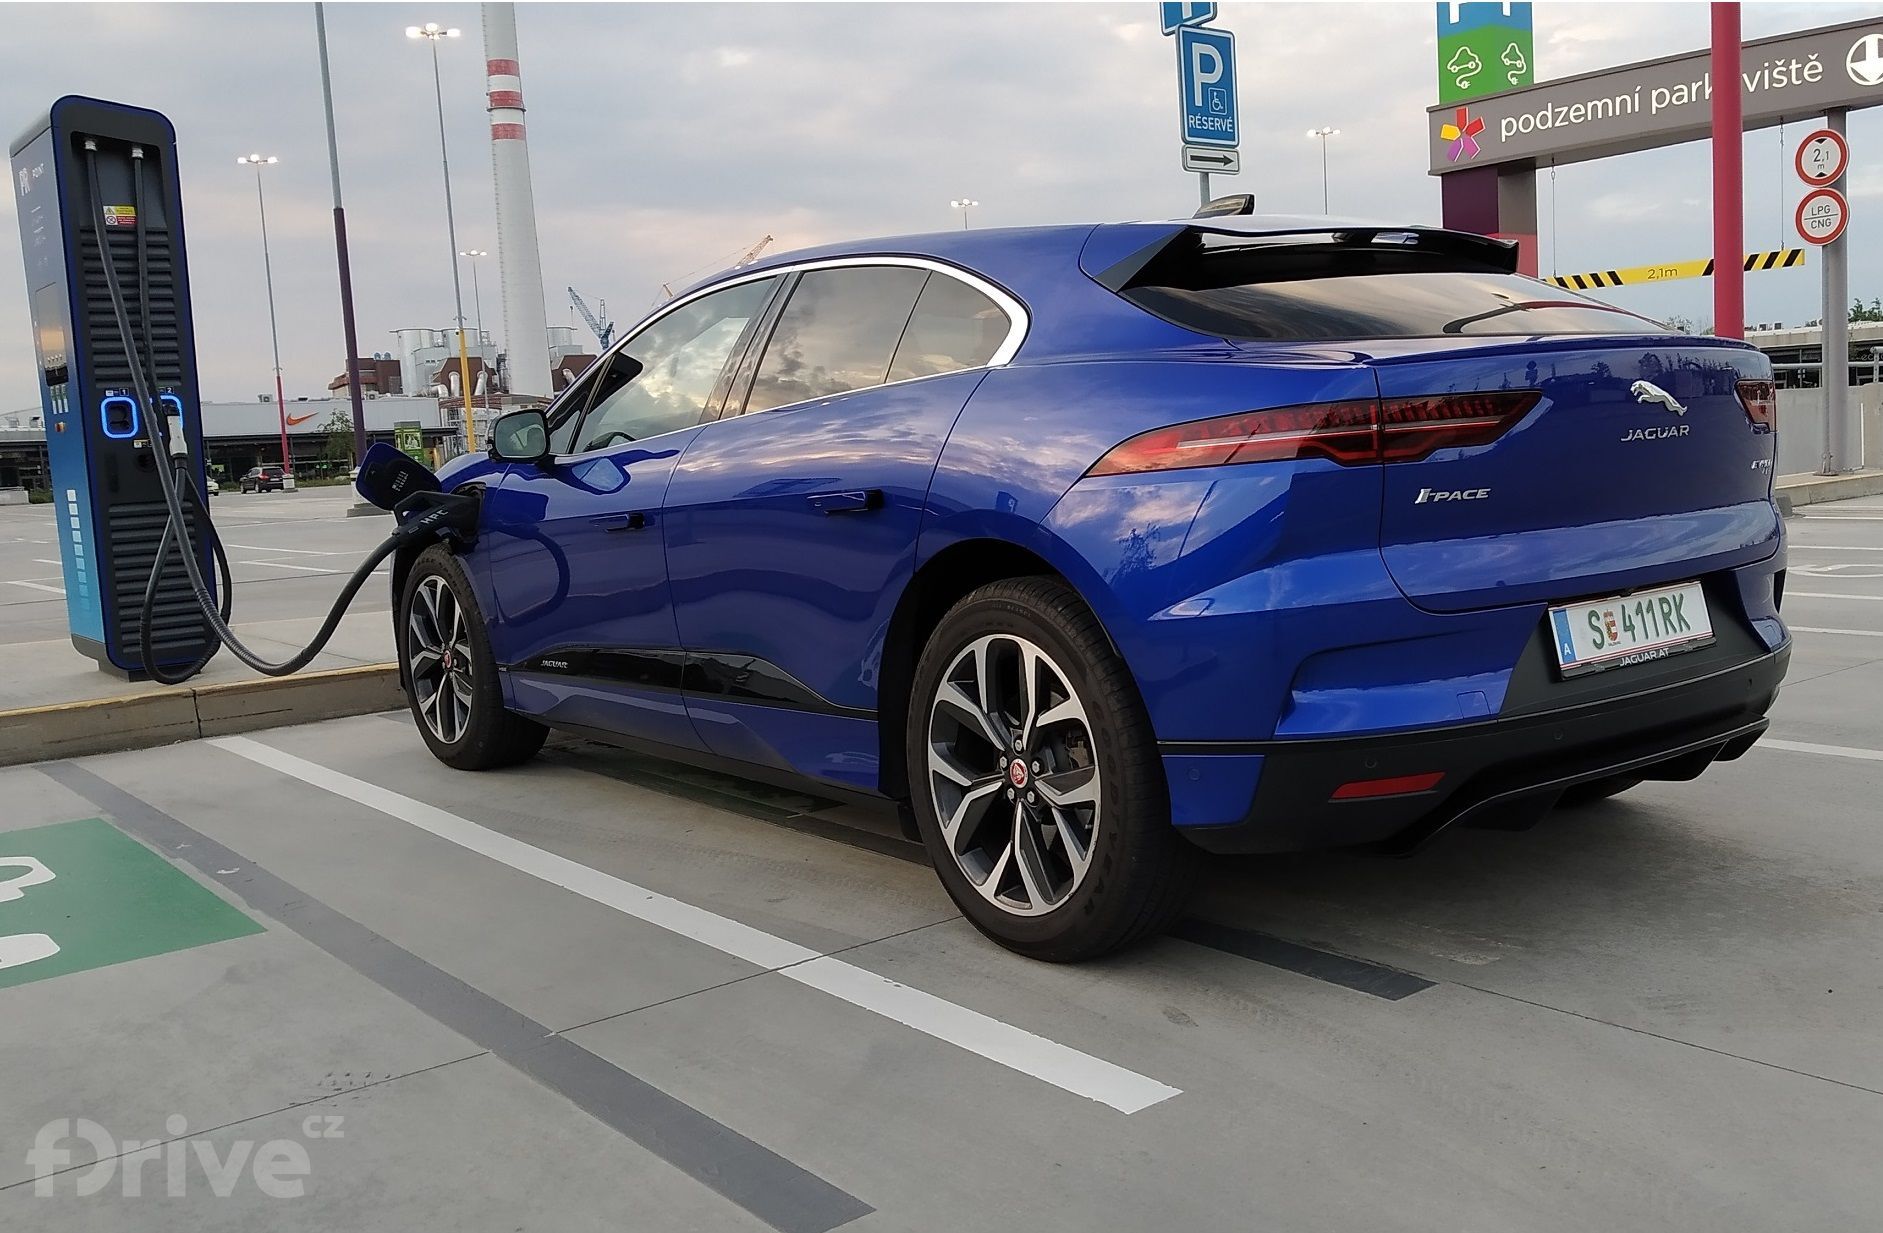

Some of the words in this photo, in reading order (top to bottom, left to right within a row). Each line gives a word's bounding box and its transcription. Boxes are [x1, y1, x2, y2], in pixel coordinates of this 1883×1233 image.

[1191, 42, 1224, 107] P
[1501, 85, 1642, 142] podzemní
[1651, 53, 1823, 115] parkviště
[1188, 113, 1233, 132] RÉSERVÉ
[1813, 148, 1830, 163] 2,1
[1811, 204, 1831, 216] LPG
[1810, 218, 1832, 229] CNG
[1647, 267, 1678, 280] 2,1m
[1621, 425, 1690, 441] JAGUAR
[1415, 488, 1491, 504] I-PACE
[1588, 610, 1605, 650] S
[1562, 643, 1572, 655] A
[540, 660, 569, 669] JAGUAR
